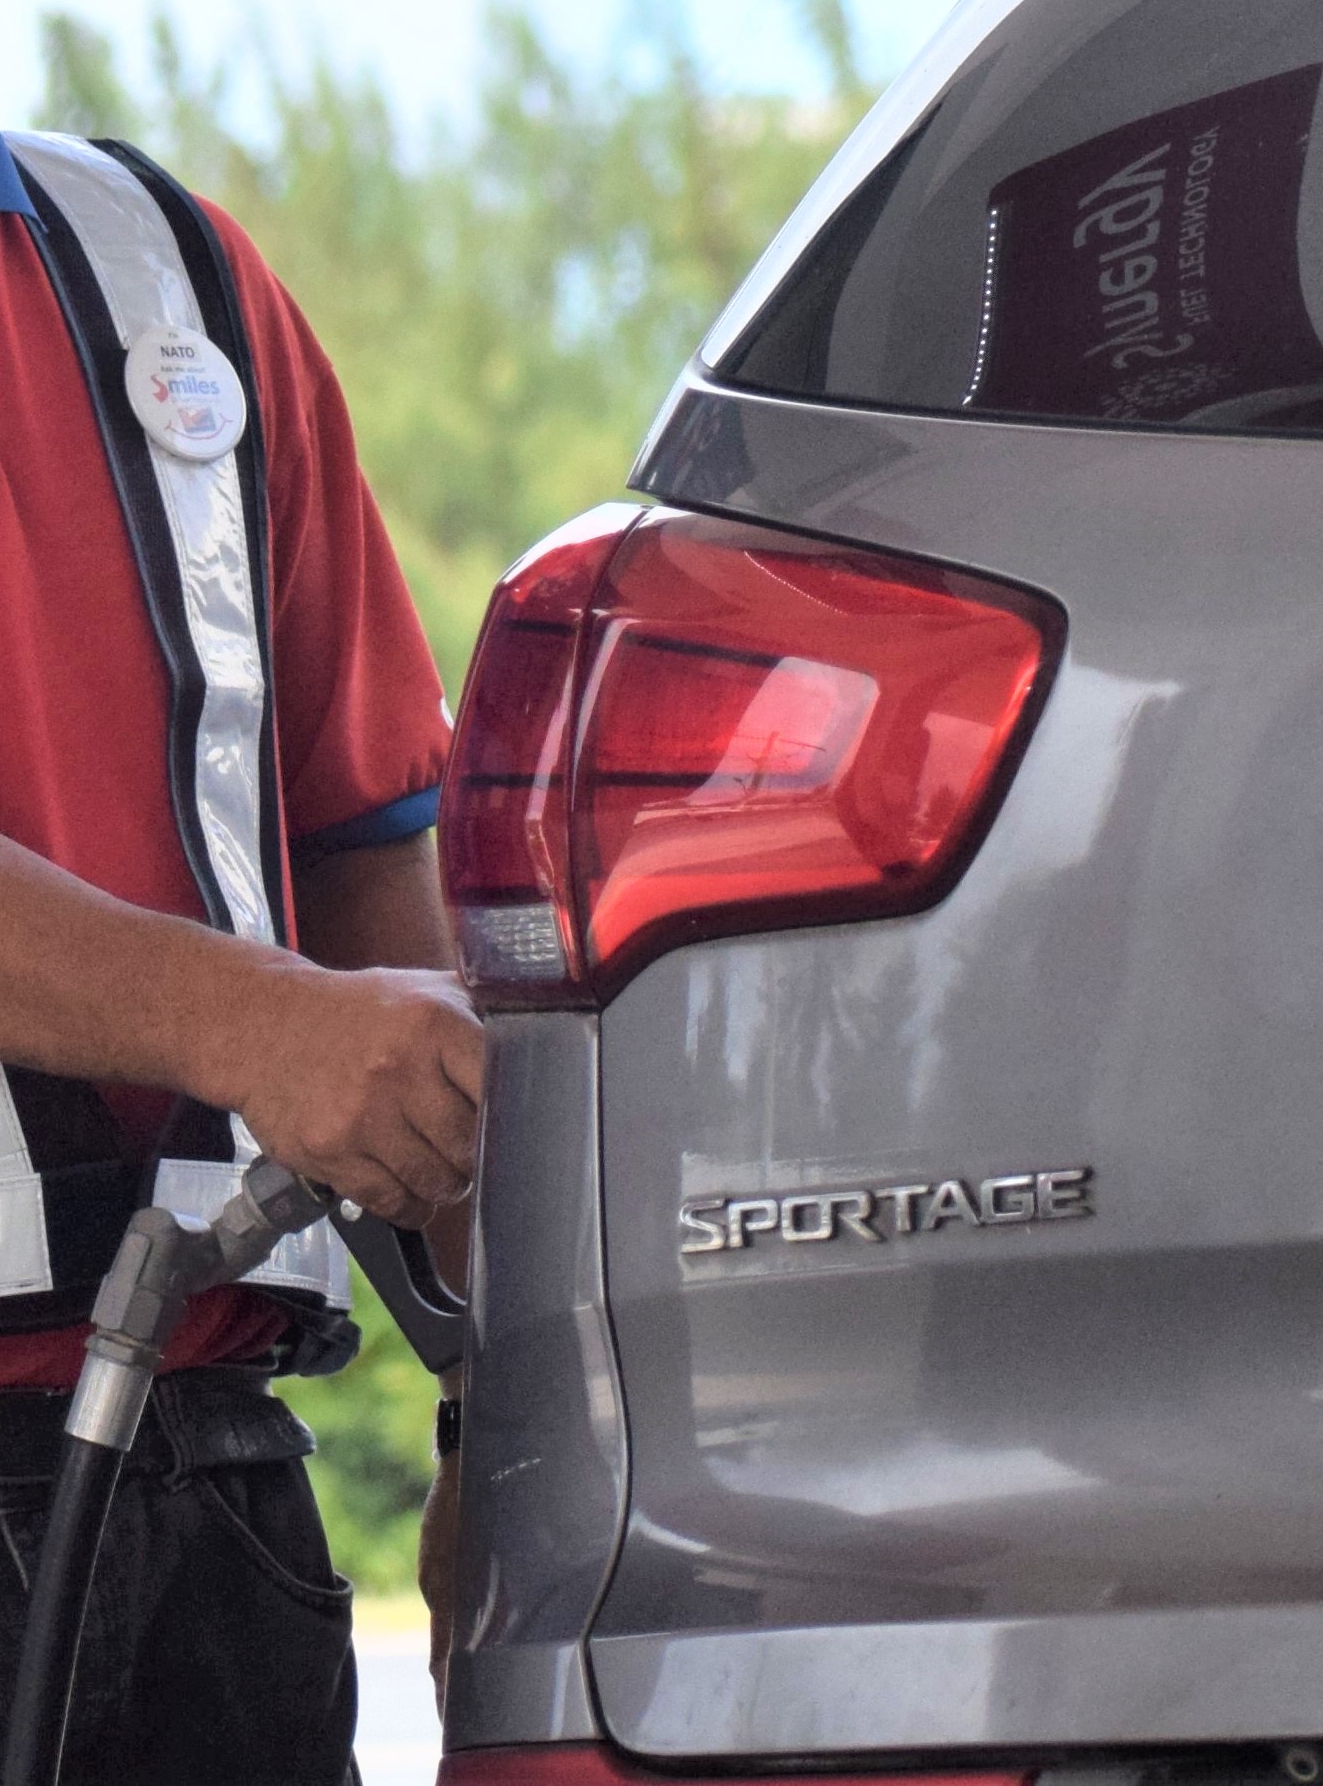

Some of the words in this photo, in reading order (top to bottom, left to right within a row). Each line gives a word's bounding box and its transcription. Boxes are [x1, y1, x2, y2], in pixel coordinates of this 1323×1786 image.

[160, 345, 195, 359] NATO
[150, 373, 220, 404] Smiles
[678, 1165, 1094, 1255] SPORTAGE
